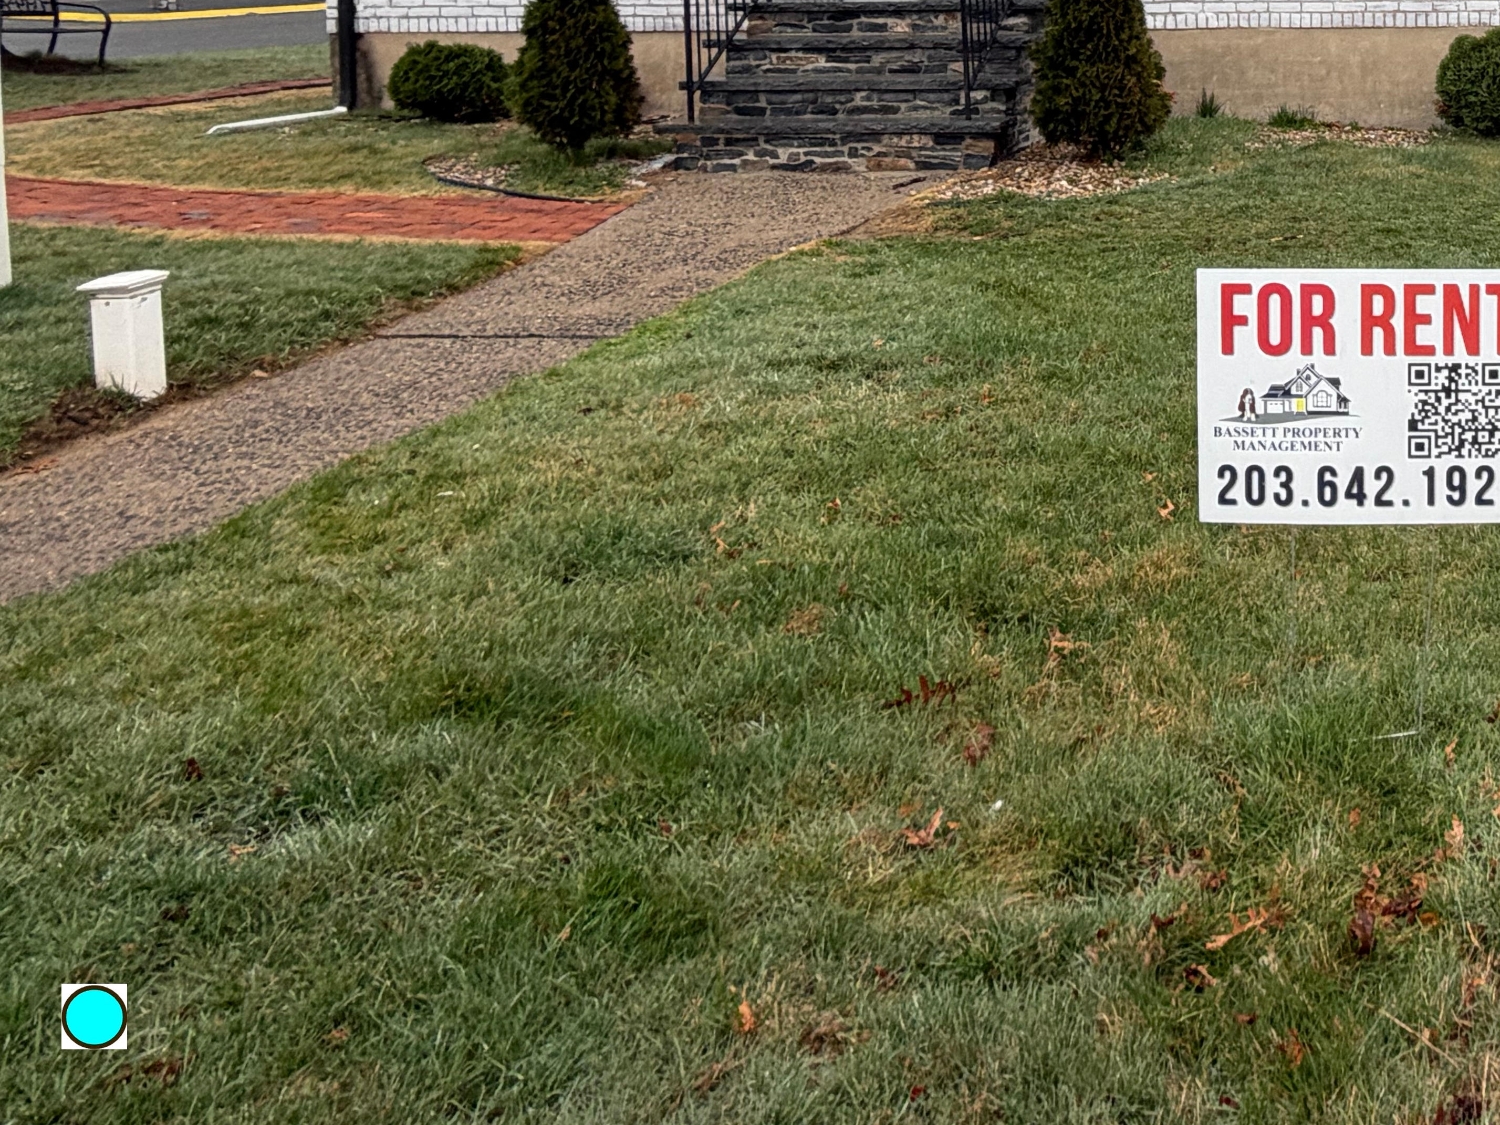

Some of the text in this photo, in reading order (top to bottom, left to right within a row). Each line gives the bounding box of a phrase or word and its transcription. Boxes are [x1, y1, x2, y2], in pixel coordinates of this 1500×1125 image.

[1220, 282, 1337, 357] FOR
[1213, 426, 1363, 439] BASSETT PROPERTY
[1232, 440, 1343, 452] MANAGEMENT
